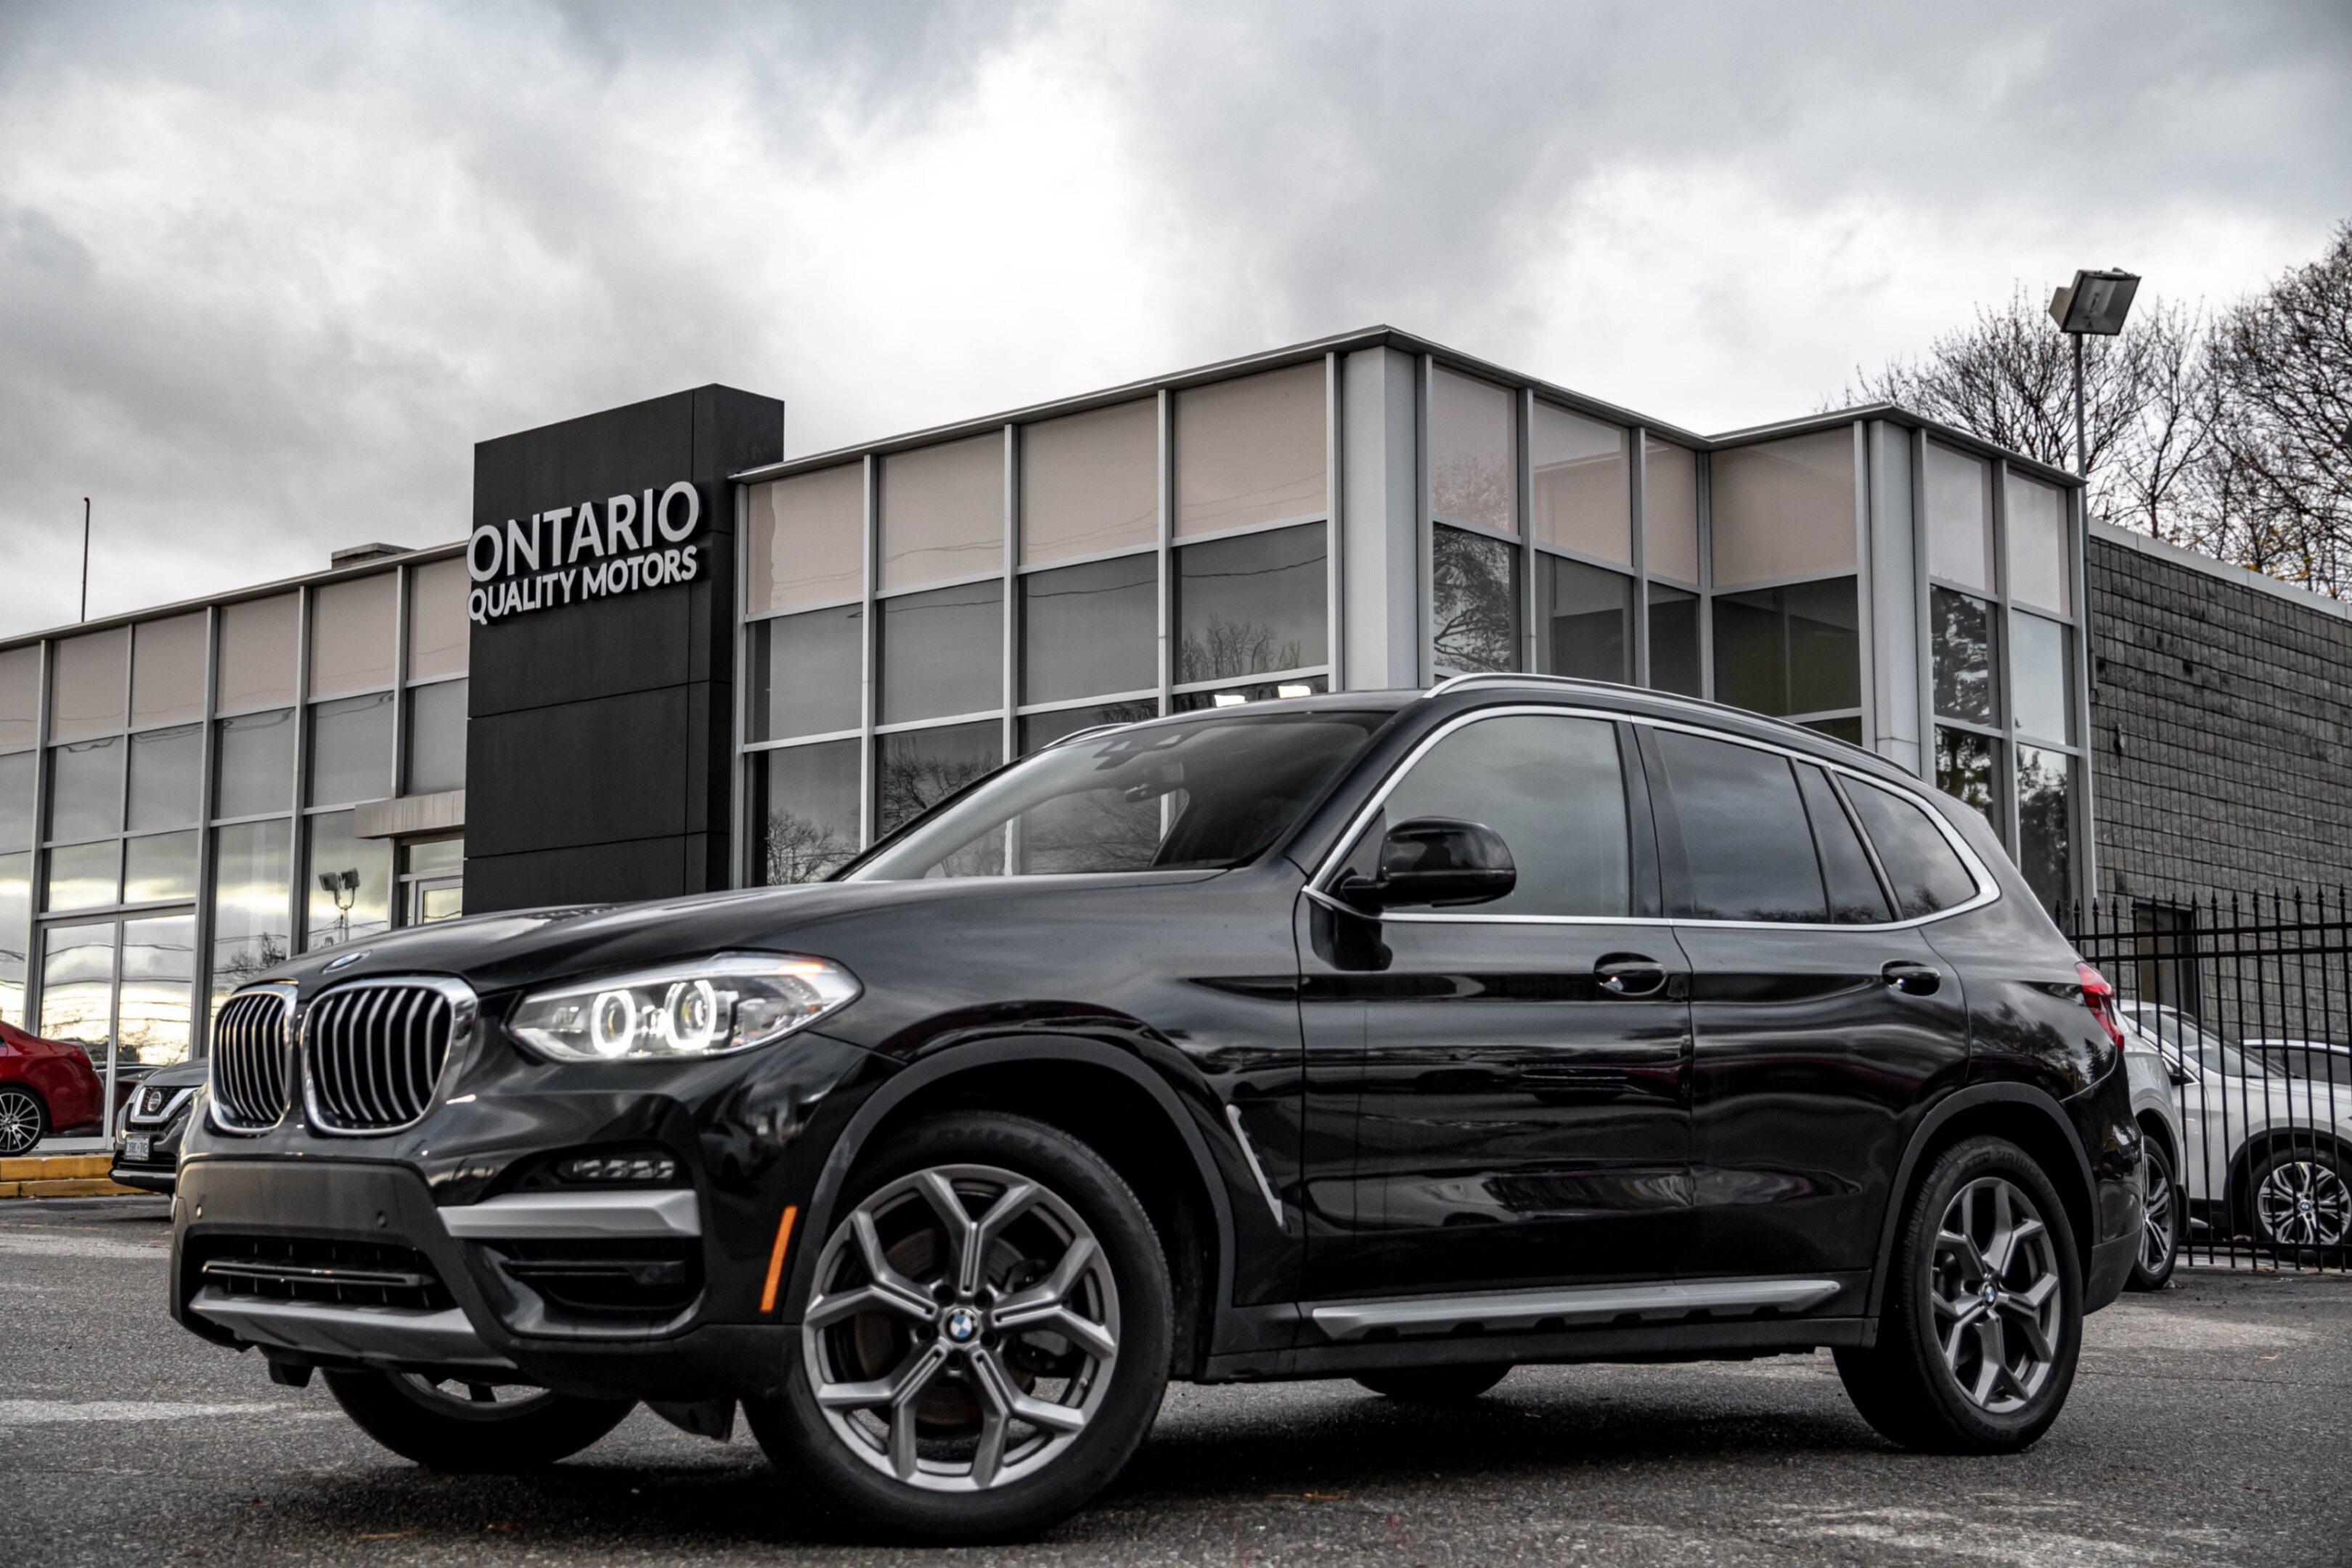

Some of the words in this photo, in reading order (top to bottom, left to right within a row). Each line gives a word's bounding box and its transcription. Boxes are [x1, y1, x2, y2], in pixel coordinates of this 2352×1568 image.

[466, 481, 701, 582] ONTARIO
[467, 568, 577, 626] QUALITY
[581, 544, 698, 600] MOTORS
